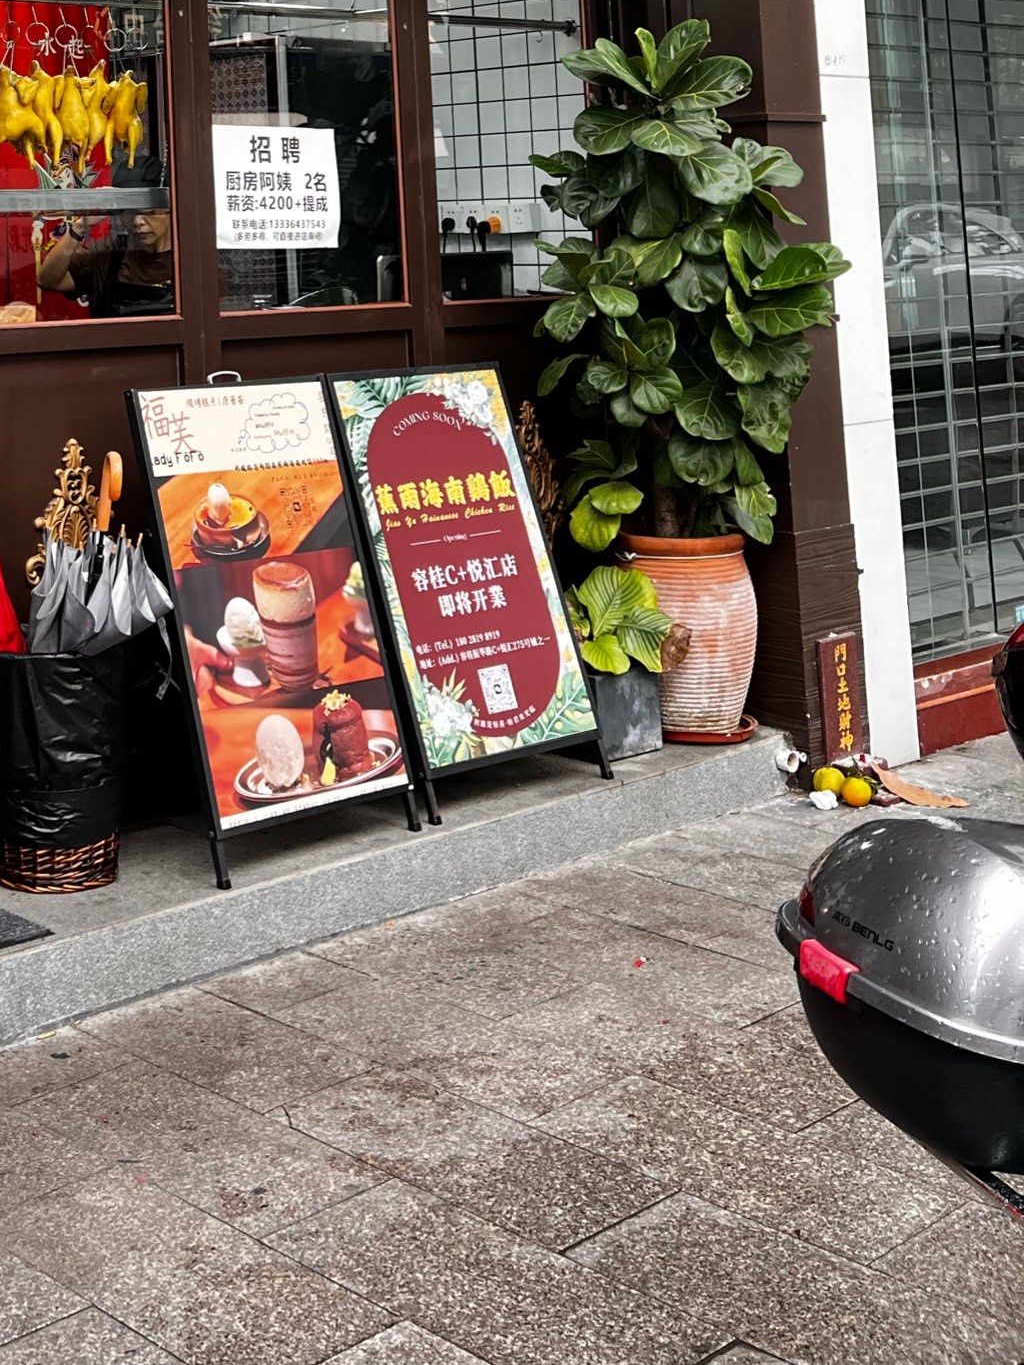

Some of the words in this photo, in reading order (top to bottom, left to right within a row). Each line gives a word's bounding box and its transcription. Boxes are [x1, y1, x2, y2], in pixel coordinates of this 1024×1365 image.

[249, 134, 301, 164] 招聘
[225, 170, 293, 192] 厨房阿姨
[303, 172, 328, 193] 2名
[393, 410, 430, 436] COMING
[151, 453, 174, 467] ady
[411, 553, 518, 592] 容桂C+悦汇店
